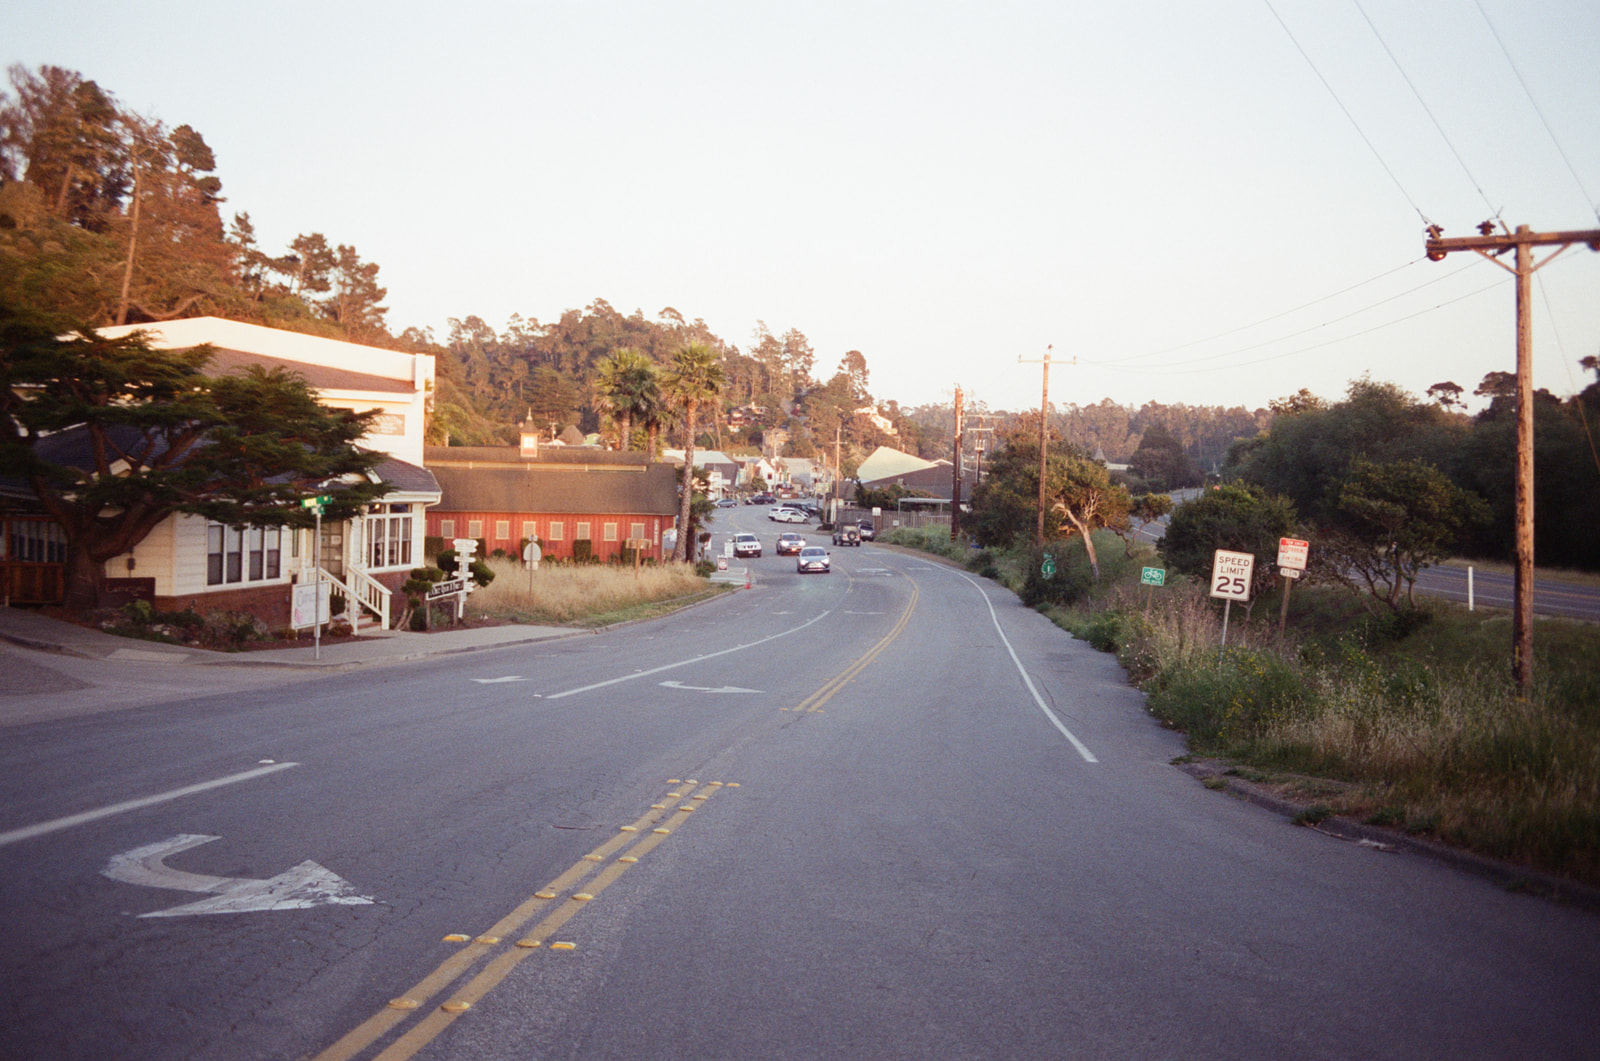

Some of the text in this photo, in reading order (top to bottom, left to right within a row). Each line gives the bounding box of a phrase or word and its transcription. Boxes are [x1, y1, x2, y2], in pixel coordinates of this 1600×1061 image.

[1218, 556, 1249, 566] SPEED
[1220, 566, 1245, 576] LIMIT
[1216, 576, 1246, 595] 25
